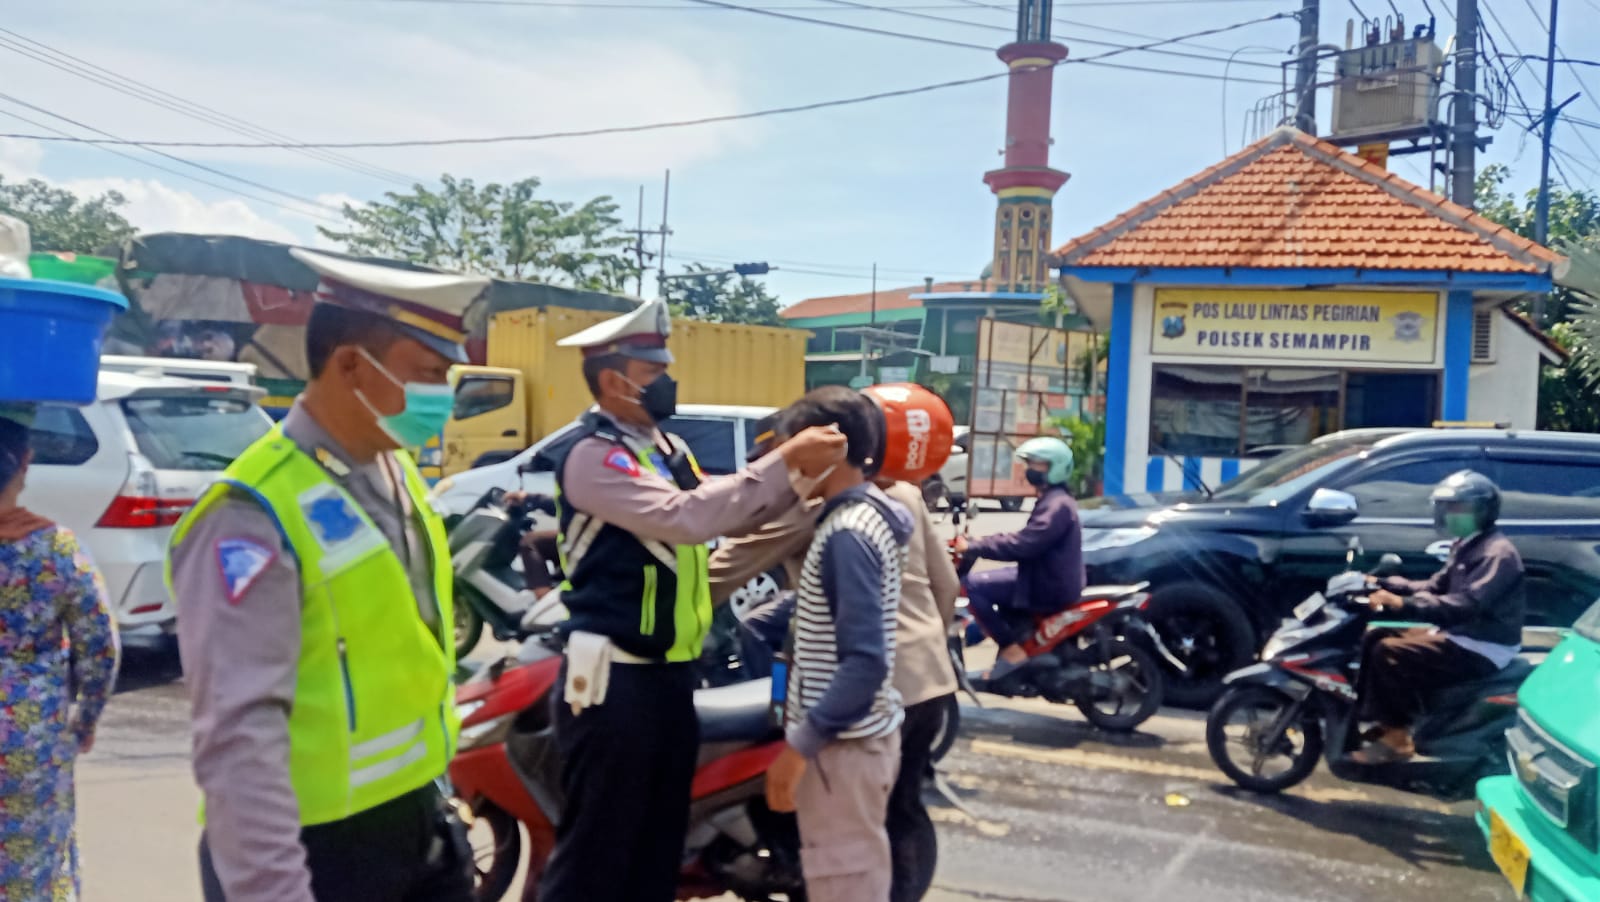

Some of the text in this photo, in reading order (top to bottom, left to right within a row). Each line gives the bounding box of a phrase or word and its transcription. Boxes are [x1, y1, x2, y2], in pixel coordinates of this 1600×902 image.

[1193, 303, 1219, 319] POS
[1224, 303, 1257, 320] LALU
[1261, 304, 1308, 321] LINTAS
[1313, 304, 1380, 322] PEGIRIAN
[1197, 331, 1370, 351] POLSEK SEMAMPIR
